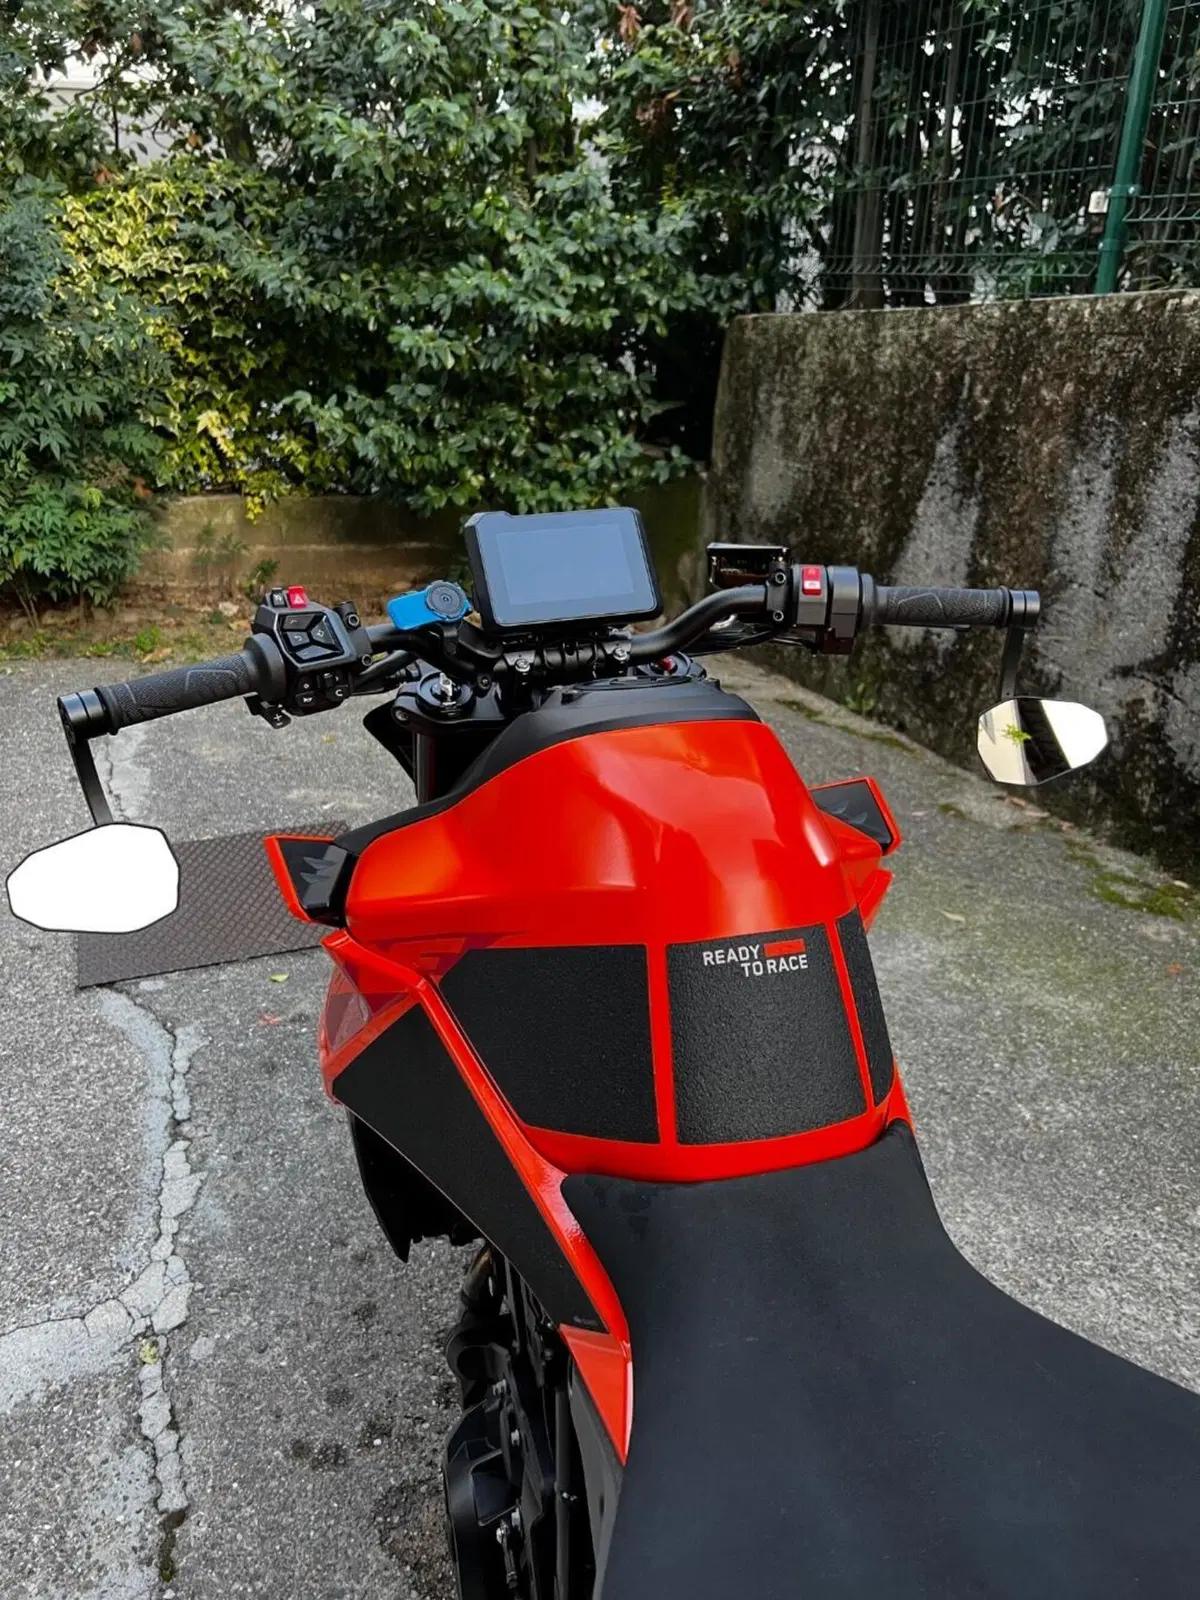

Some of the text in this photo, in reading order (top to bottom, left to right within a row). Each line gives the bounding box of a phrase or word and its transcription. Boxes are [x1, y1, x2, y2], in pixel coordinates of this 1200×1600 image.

[702, 944, 760, 966] READY
[740, 954, 808, 977] TO RACE
